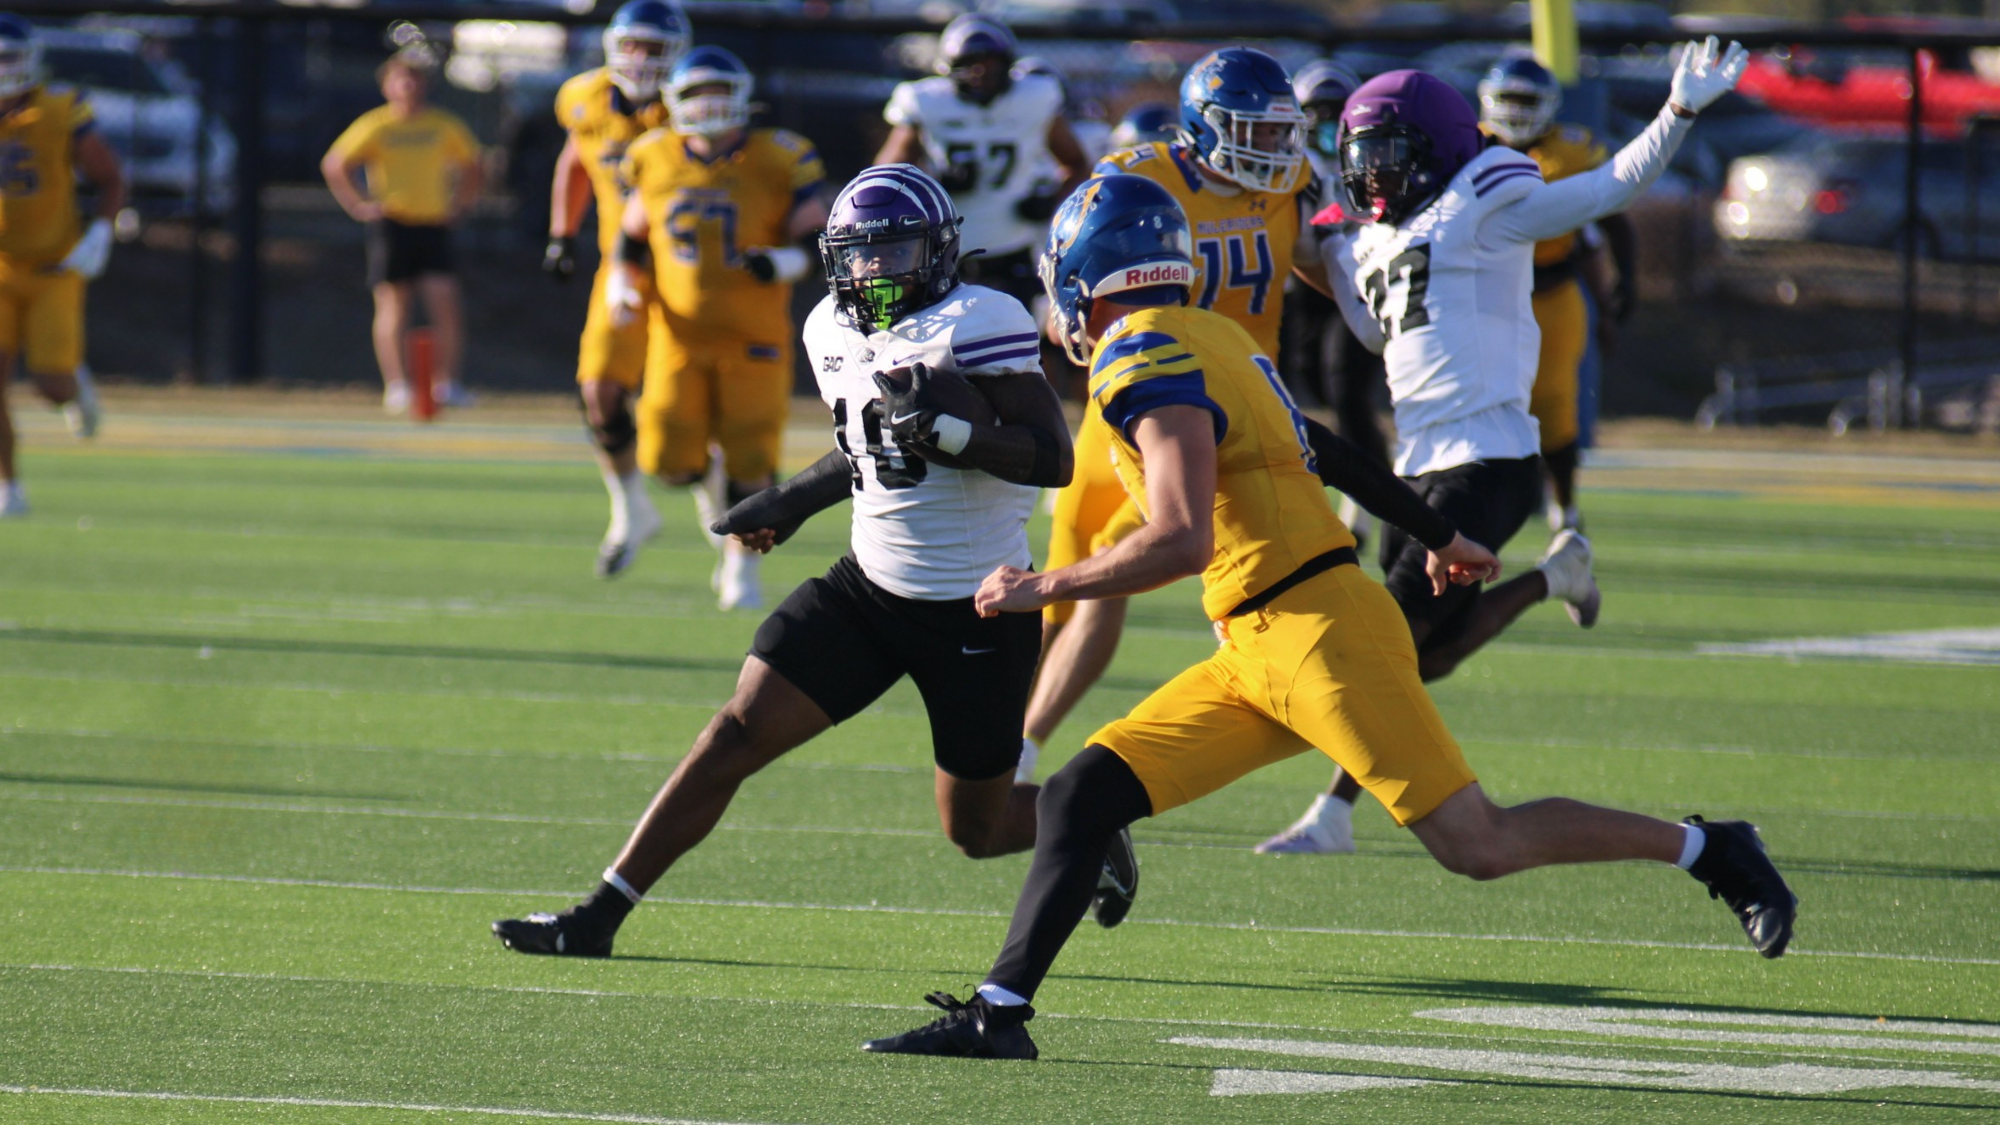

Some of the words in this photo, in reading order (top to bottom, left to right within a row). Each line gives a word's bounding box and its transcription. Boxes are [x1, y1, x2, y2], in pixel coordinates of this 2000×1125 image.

[855, 218, 889, 230] Riddell
[1153, 215, 1162, 229] 8
[1125, 265, 1189, 286] Riddell
[1196, 231, 1275, 314] 14
[823, 355, 844, 372] GAC
